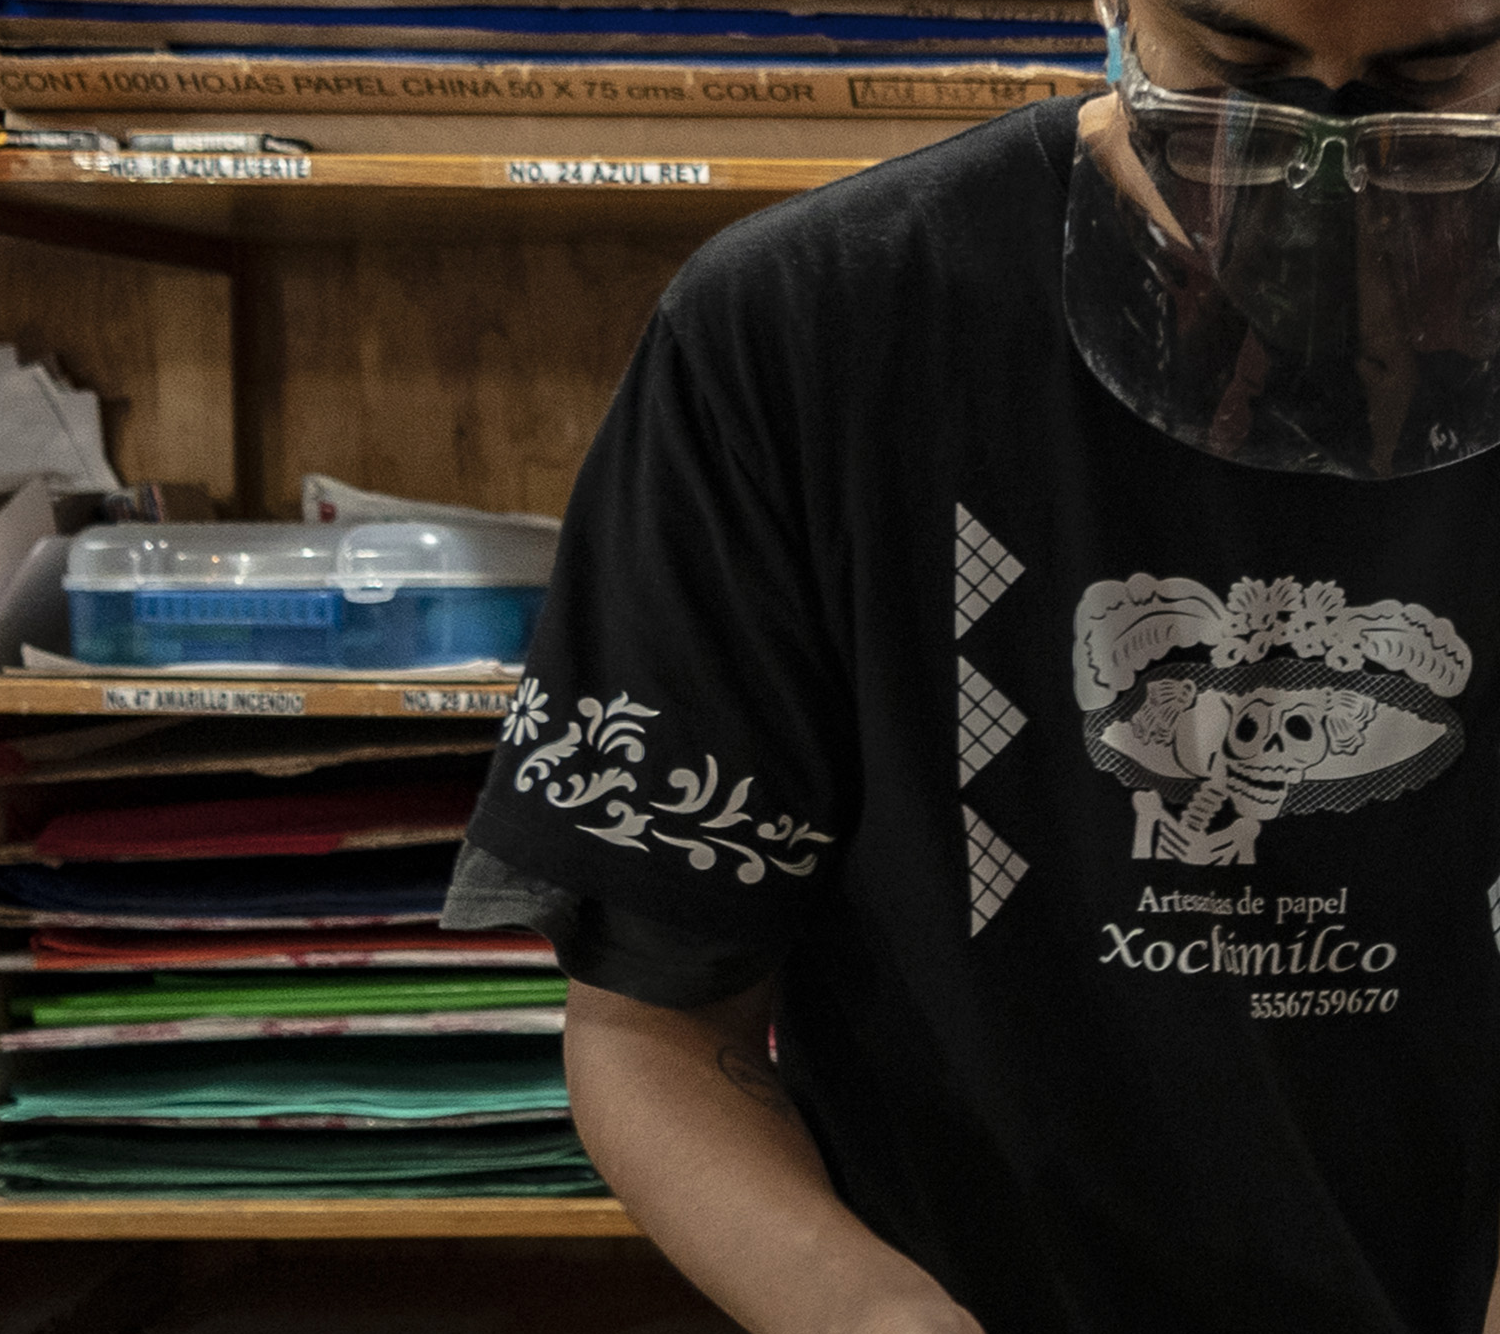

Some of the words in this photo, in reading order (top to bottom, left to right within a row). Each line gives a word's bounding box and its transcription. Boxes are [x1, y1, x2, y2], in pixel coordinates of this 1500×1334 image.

[180, 72, 286, 96] HOJAS
[296, 72, 394, 98] PAPEL
[403, 75, 501, 100] CHINA
[510, 78, 543, 101] 50
[553, 80, 574, 101] X
[583, 81, 619, 102] 75
[626, 82, 694, 103] cms.
[703, 81, 815, 104] COLOR
[177, 157, 227, 179] AZUL
[509, 162, 543, 185] NO.
[557, 162, 584, 182] 24
[592, 162, 648, 185] AZUL
[658, 163, 701, 184] REY
[1235, 885, 1266, 915] de
[1275, 886, 1348, 925] papel
[1098, 922, 1398, 976] Xochimilco
[1249, 988, 1400, 1020] 5556759670
